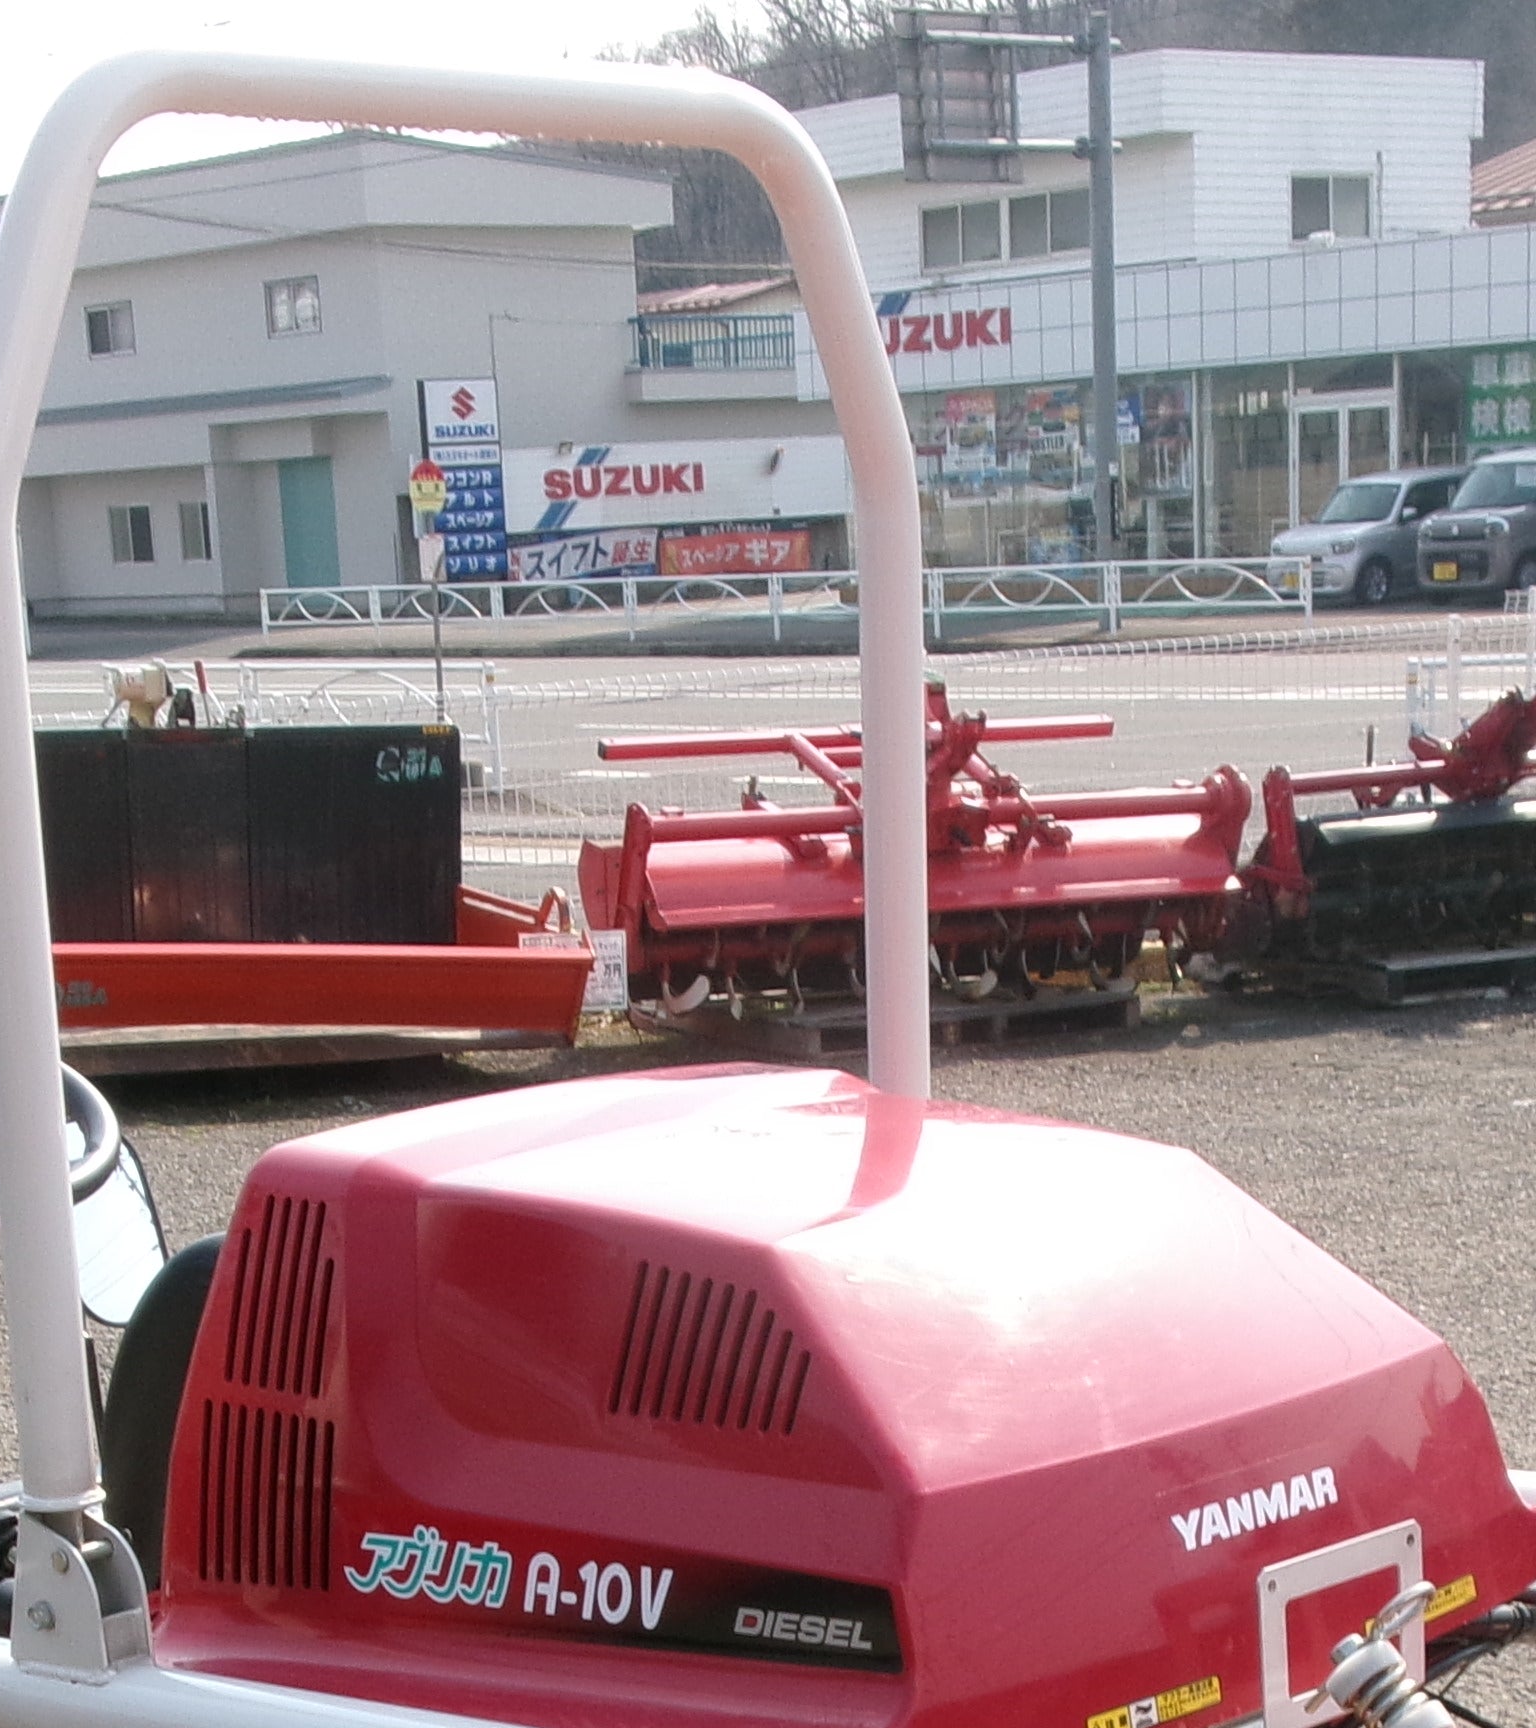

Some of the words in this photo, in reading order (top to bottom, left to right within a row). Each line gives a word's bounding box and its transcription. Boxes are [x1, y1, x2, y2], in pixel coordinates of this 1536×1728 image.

[876, 307, 1012, 355] UZUKI
[435, 423, 495, 439] SUZUKI
[543, 461, 705, 499] SUZUKI
[448, 533, 498, 551] スイフト
[525, 536, 609, 580] スイフト
[744, 538, 791, 566] ギア
[1170, 1465, 1339, 1552] YANMAR
[343, 1523, 513, 1610] アグリカ
[523, 1552, 674, 1631] A-10V
[733, 1606, 873, 1651] DIESEL
